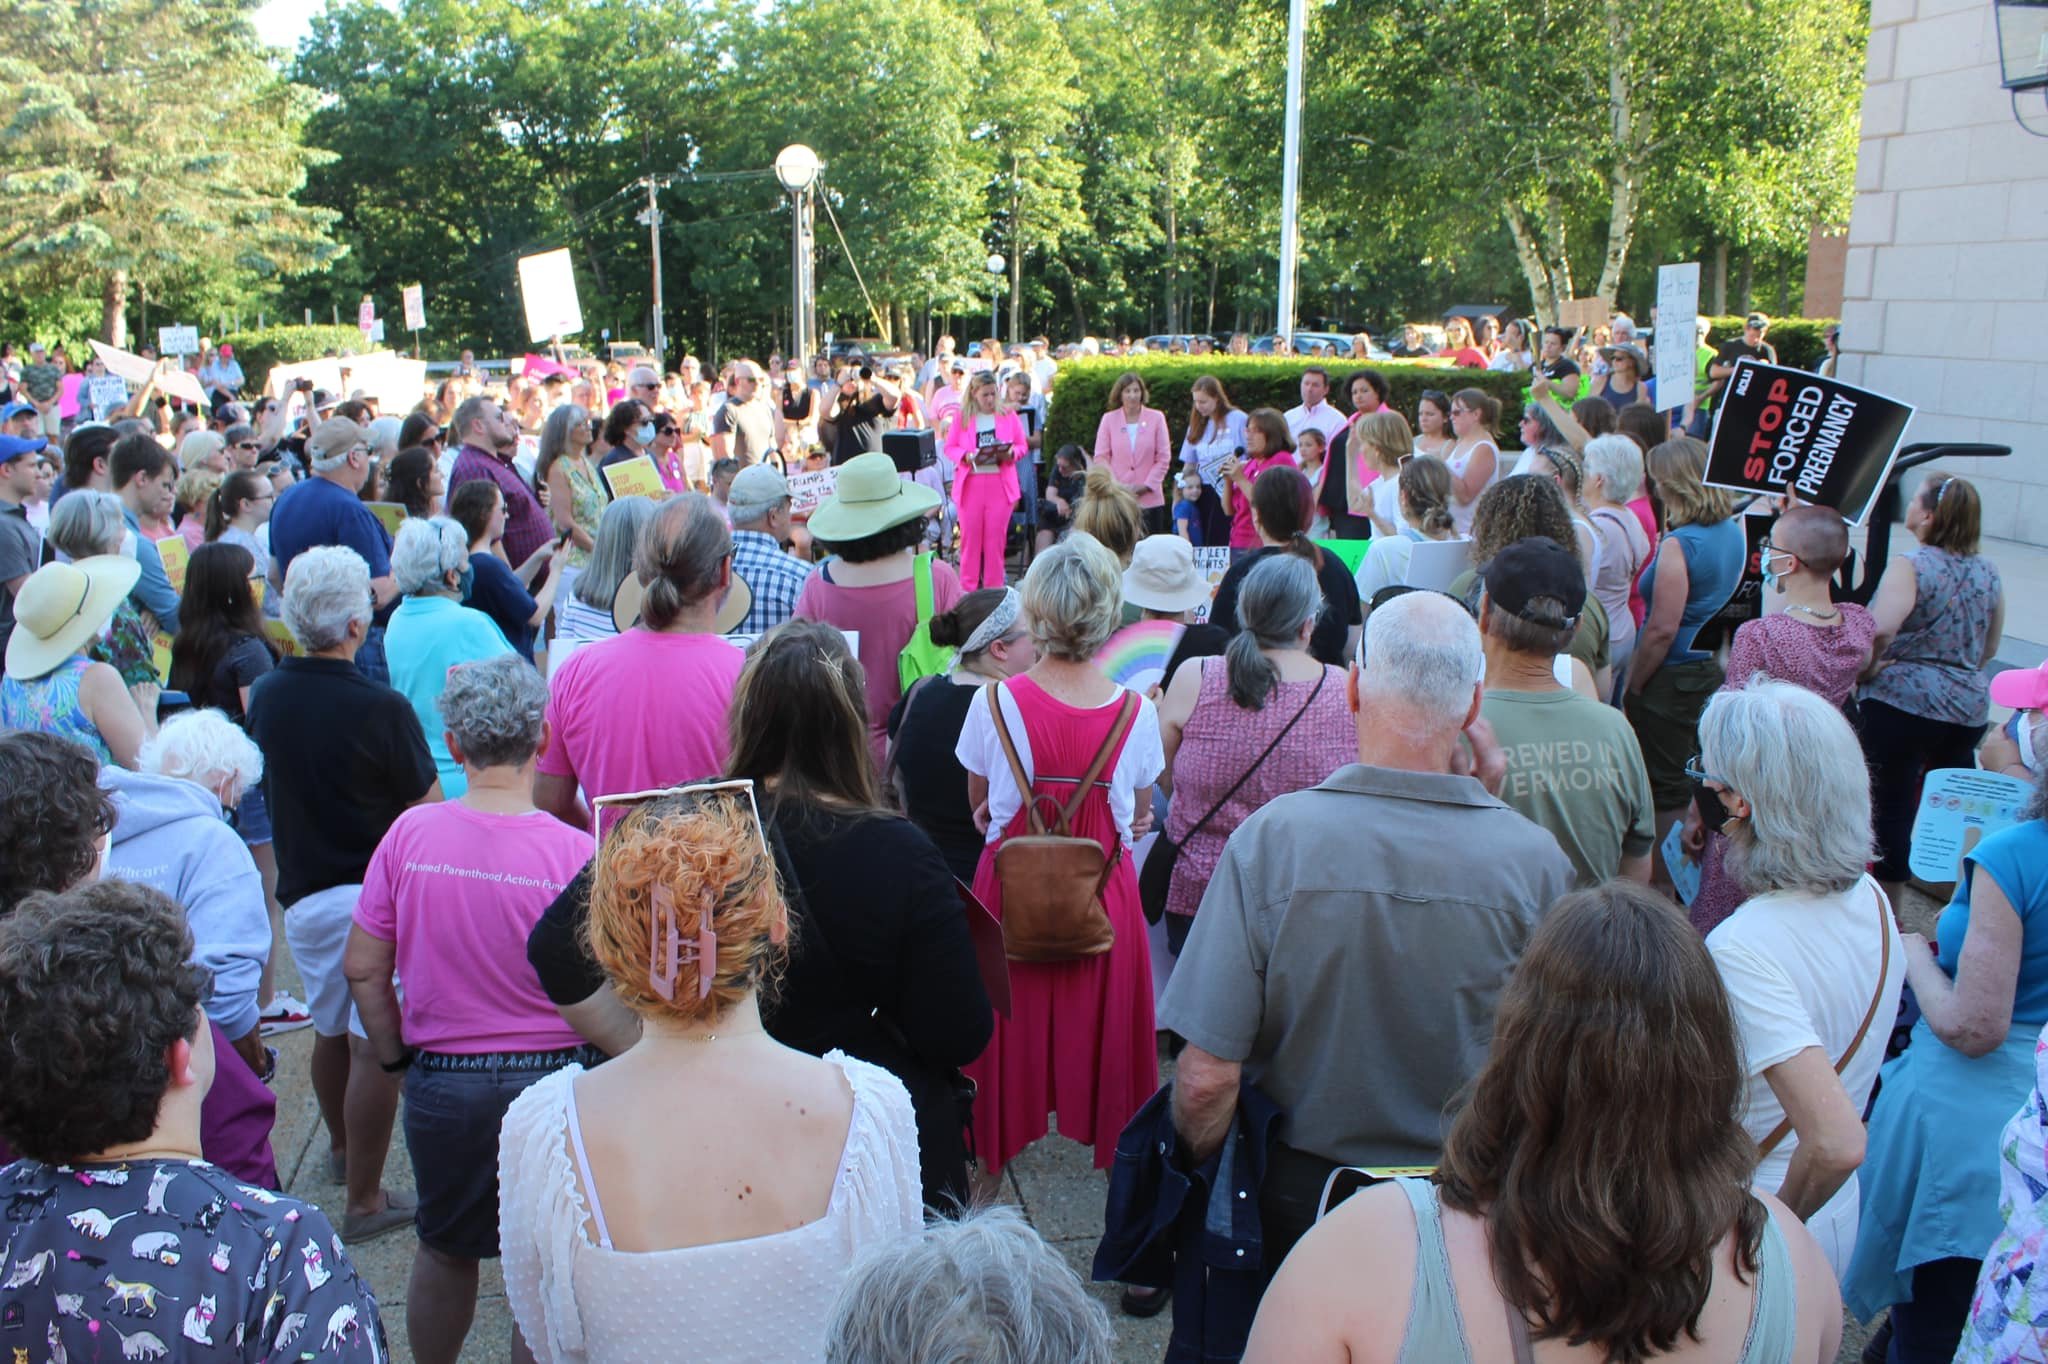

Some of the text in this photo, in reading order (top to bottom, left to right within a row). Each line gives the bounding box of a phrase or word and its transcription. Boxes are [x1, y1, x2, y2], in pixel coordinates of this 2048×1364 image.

[1736, 369, 1754, 396] ACLU
[1744, 378, 1790, 482] STOP
[1767, 385, 1824, 485] FORCED
[1795, 393, 1858, 495] PREGNANCY
[1208, 548, 1228, 558] LET
[276, 639, 296, 656] TOP
[1500, 741, 1592, 768] REWED
[405, 861, 441, 874] Planned
[442, 862, 503, 882] Parenthood
[503, 873, 540, 888] Action
